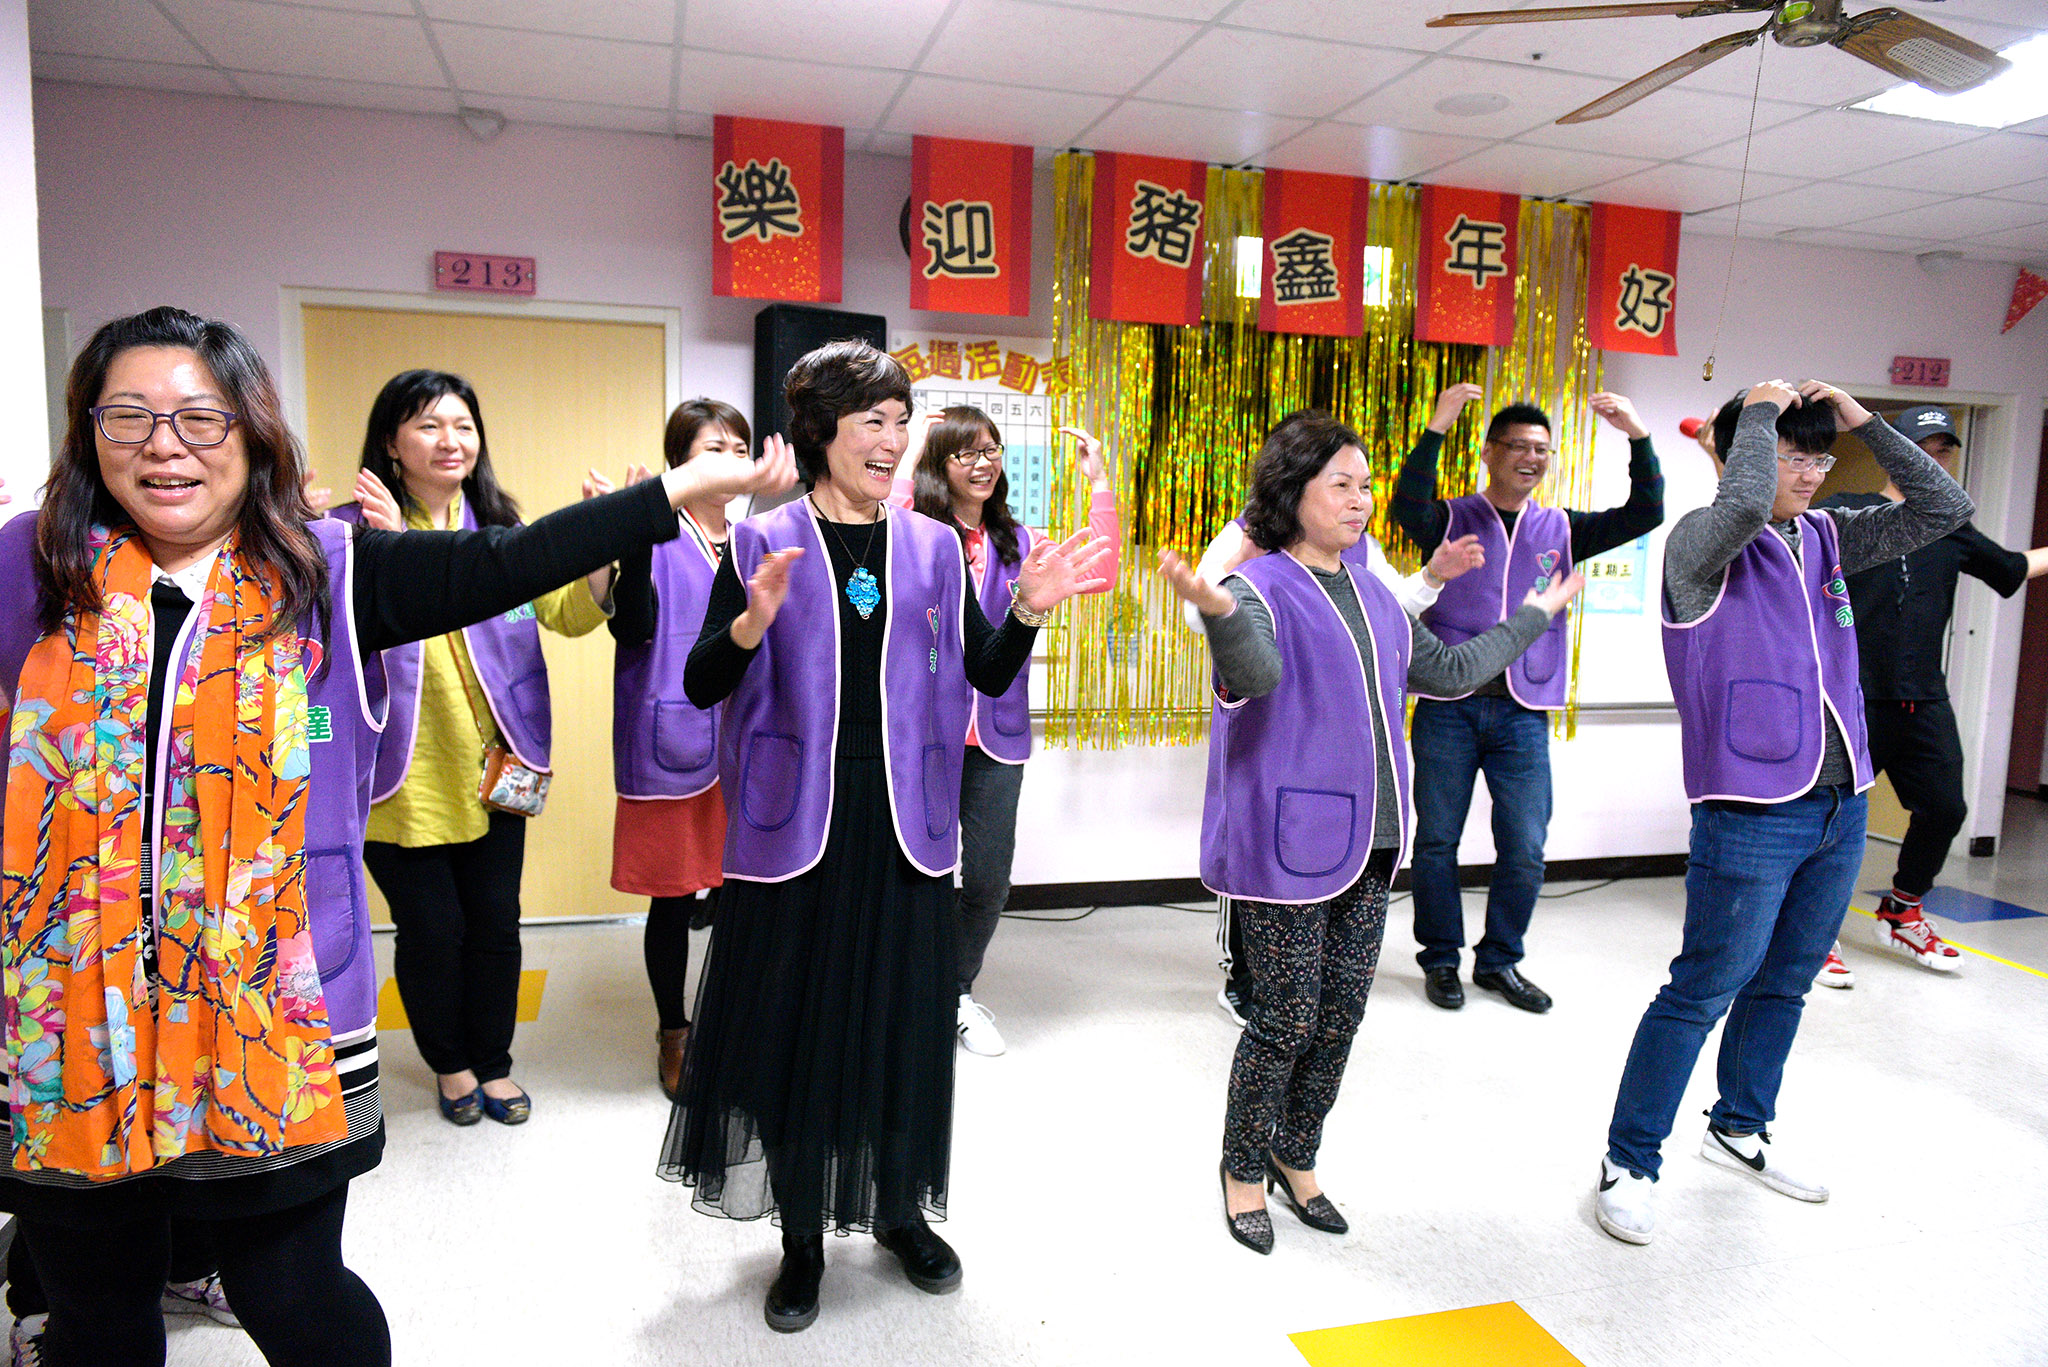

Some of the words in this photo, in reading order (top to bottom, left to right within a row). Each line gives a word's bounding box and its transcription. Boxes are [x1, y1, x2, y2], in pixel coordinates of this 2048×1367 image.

[717, 160, 802, 241] 樂
[1128, 182, 1202, 267] 豬
[451, 259, 521, 287] 213
[923, 202, 997, 275] 迎
[1273, 231, 1338, 303] 鑫
[1447, 216, 1506, 287] 年
[1619, 267, 1673, 334] 好
[1902, 361, 1943, 382] 212
[991, 402, 1003, 415] 四
[1011, 404, 1022, 416] 五
[1029, 404, 1042, 416] 六
[1591, 562, 1632, 577] 星期三
